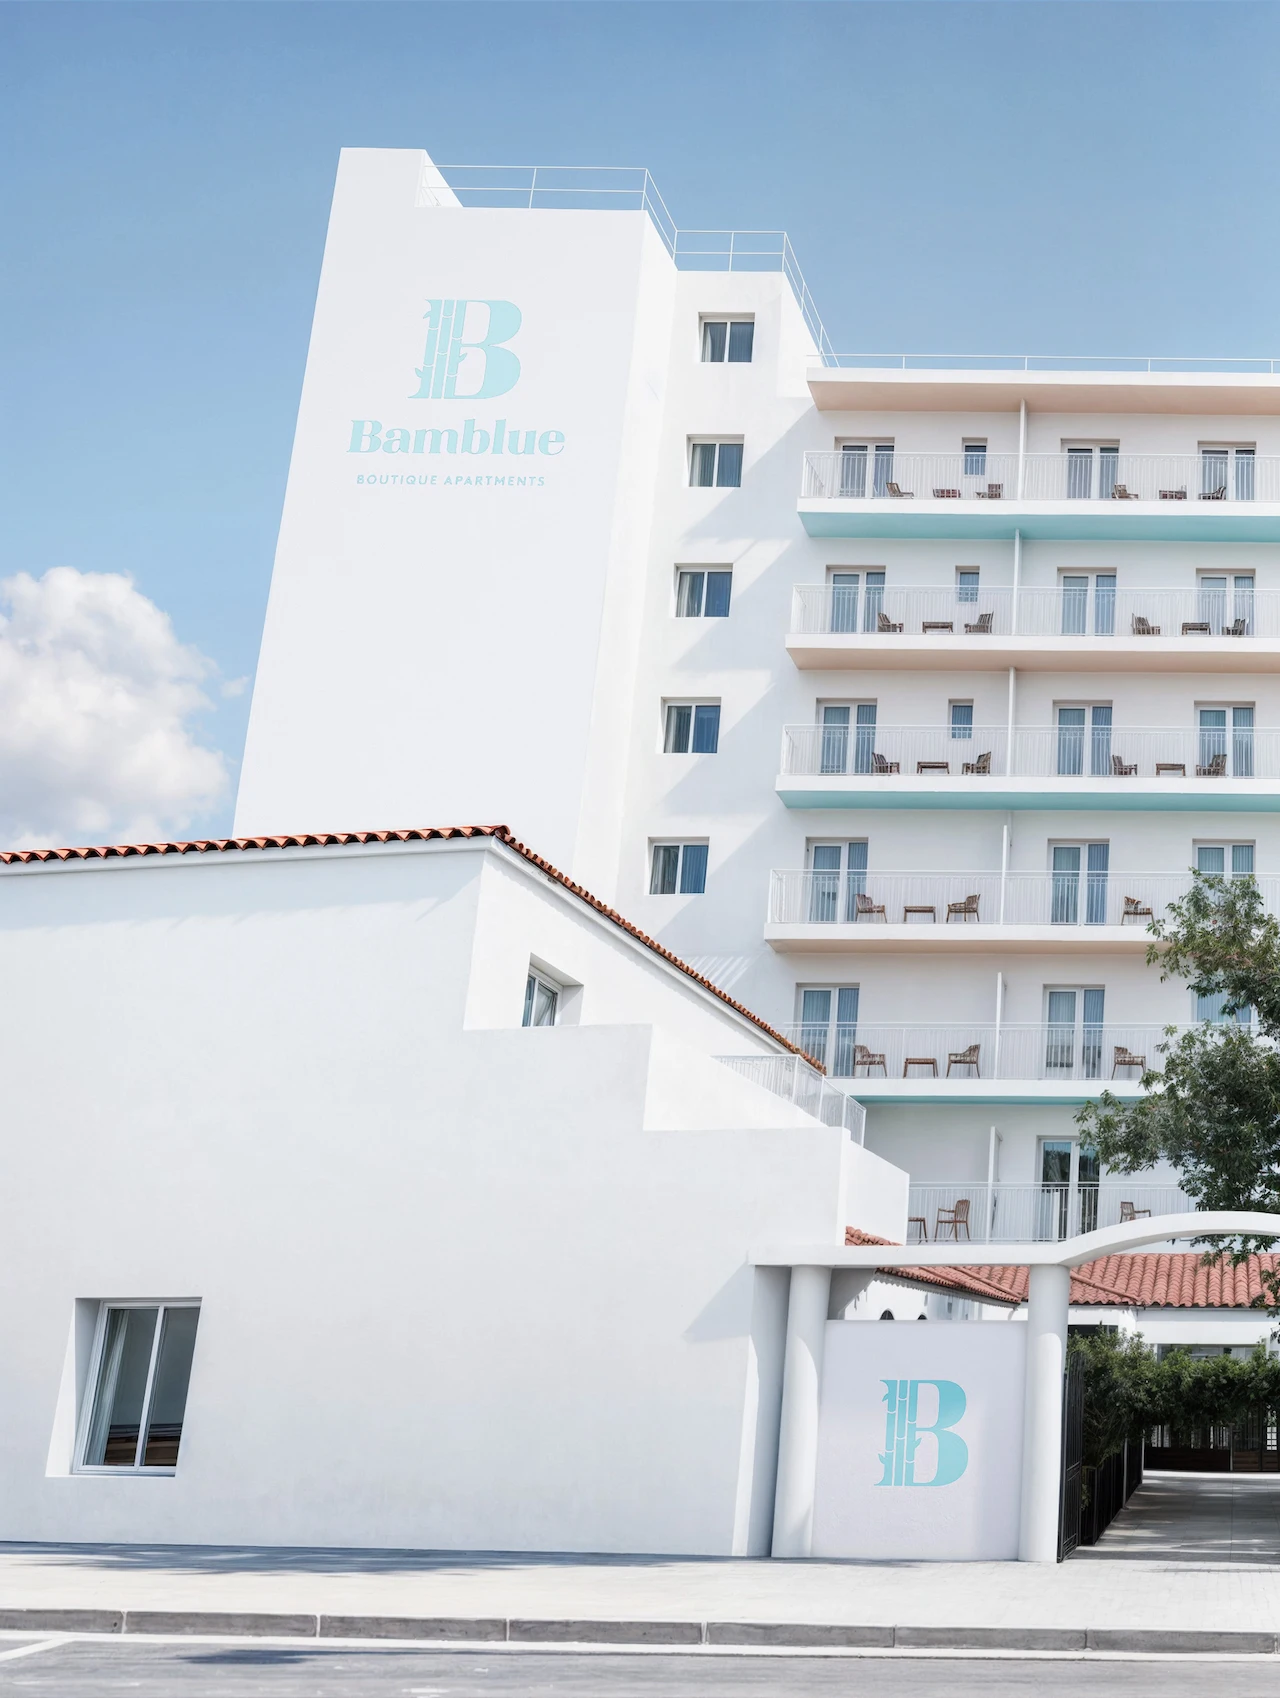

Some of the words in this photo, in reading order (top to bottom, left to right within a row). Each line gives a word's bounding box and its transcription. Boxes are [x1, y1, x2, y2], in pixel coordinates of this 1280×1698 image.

[407, 298, 522, 399] B
[346, 418, 565, 456] Bamblue
[356, 474, 438, 486] BOUTIQUE
[443, 475, 546, 487] APARTMENTS
[874, 1379, 969, 1487] B
